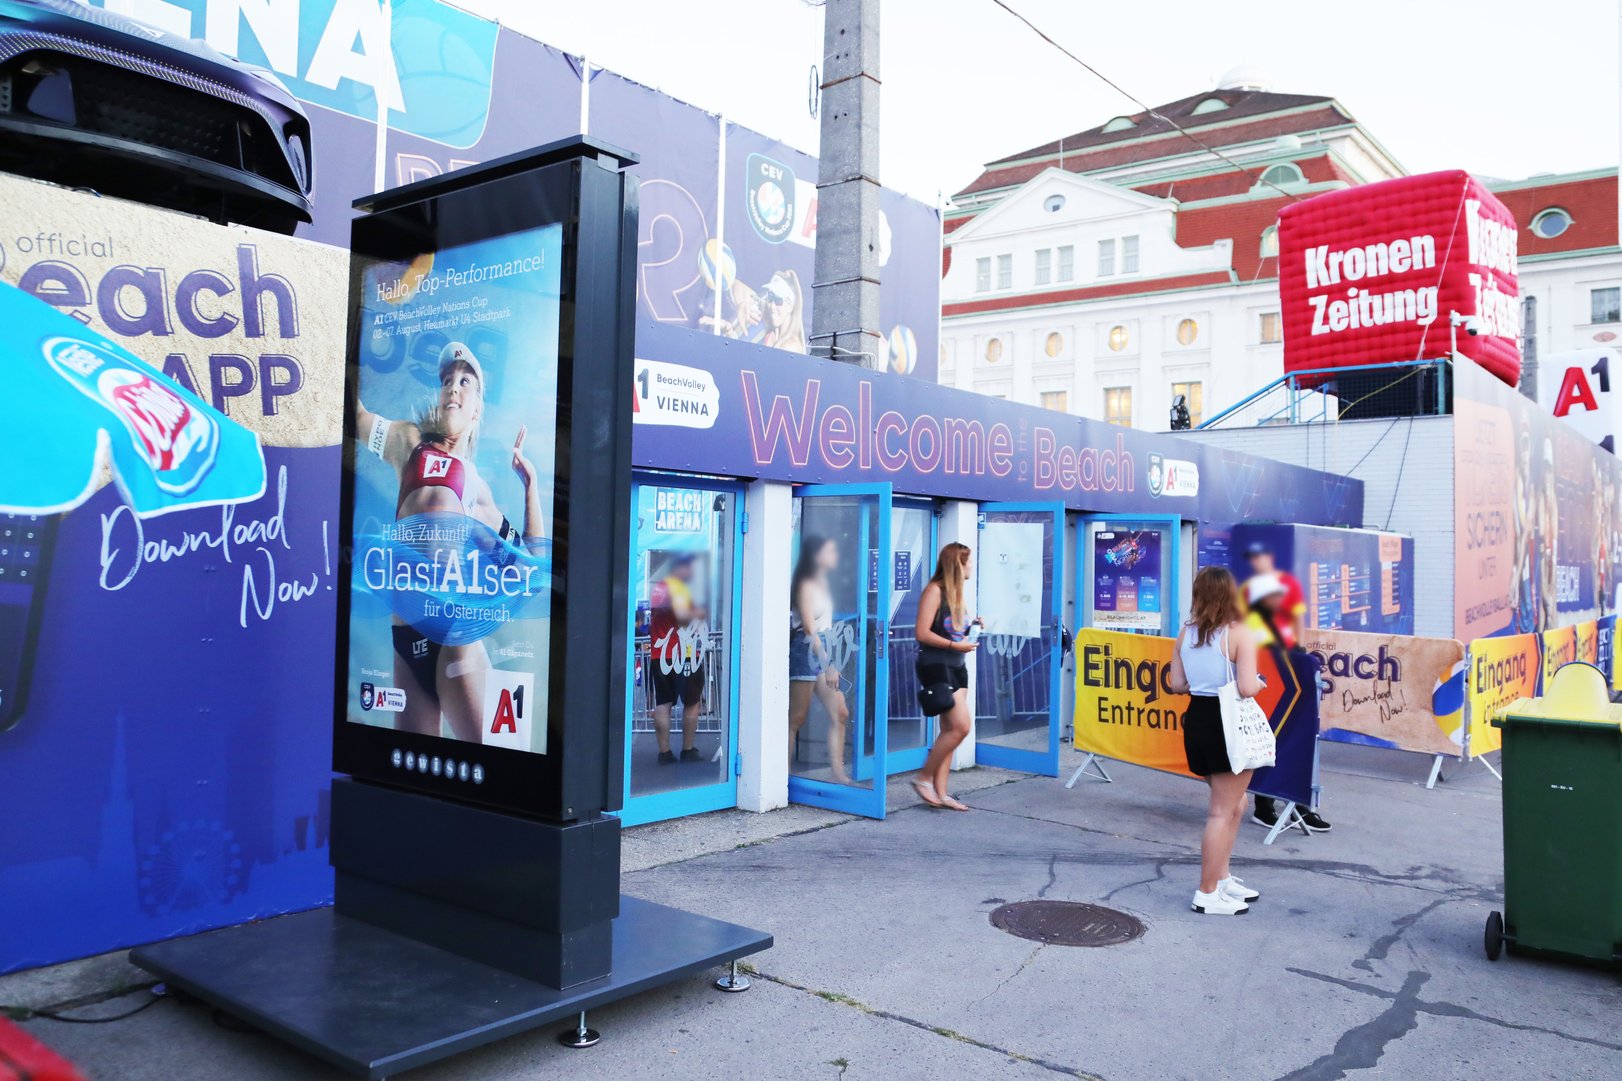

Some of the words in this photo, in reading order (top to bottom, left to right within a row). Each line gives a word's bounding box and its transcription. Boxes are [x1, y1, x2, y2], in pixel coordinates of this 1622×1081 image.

[761, 163, 784, 181] CEV
[16, 233, 114, 258] official
[1304, 234, 1436, 289] Kronen
[0, 243, 301, 339] each
[376, 279, 411, 302] Hallo,
[415, 248, 545, 296] Top-Performance!
[373, 313, 383, 325] A1
[399, 304, 442, 322] BeachVolley
[443, 300, 470, 313] Nations
[471, 296, 488, 308] Cup
[461, 313, 471, 325] U4
[472, 306, 512, 325] Stadtpark
[1308, 286, 1438, 336] Zeitung
[160, 353, 305, 417] APP
[656, 373, 706, 392] BeachVolley
[1553, 357, 1611, 418] A1
[656, 396, 709, 417] VIENNA
[740, 370, 1014, 477] Welcome
[1033, 427, 1135, 492] Beach
[428, 459, 448, 474] A1
[1166, 464, 1178, 490] A1
[657, 491, 702, 512] BEACH
[100, 465, 290, 591] Download
[382, 524, 417, 543] Hallo,
[418, 524, 470, 542] Zukunft!
[657, 512, 702, 530] ARENA
[240, 520, 332, 628] Now!
[364, 547, 538, 597] GlasfA1ser
[424, 600, 439, 617] für
[443, 600, 514, 623] Österreich.
[412, 638, 428, 655] LTE
[1306, 642, 1336, 651] official
[1309, 645, 1402, 681] each
[1083, 643, 1191, 704] Eing
[1476, 651, 1527, 695] Eingang
[376, 690, 387, 707] A1
[490, 684, 525, 734] A1
[1342, 676, 1393, 713] Download
[1379, 688, 1409, 724] Now!
[1097, 697, 1187, 731] Entran
[392, 749, 484, 784] gewista
